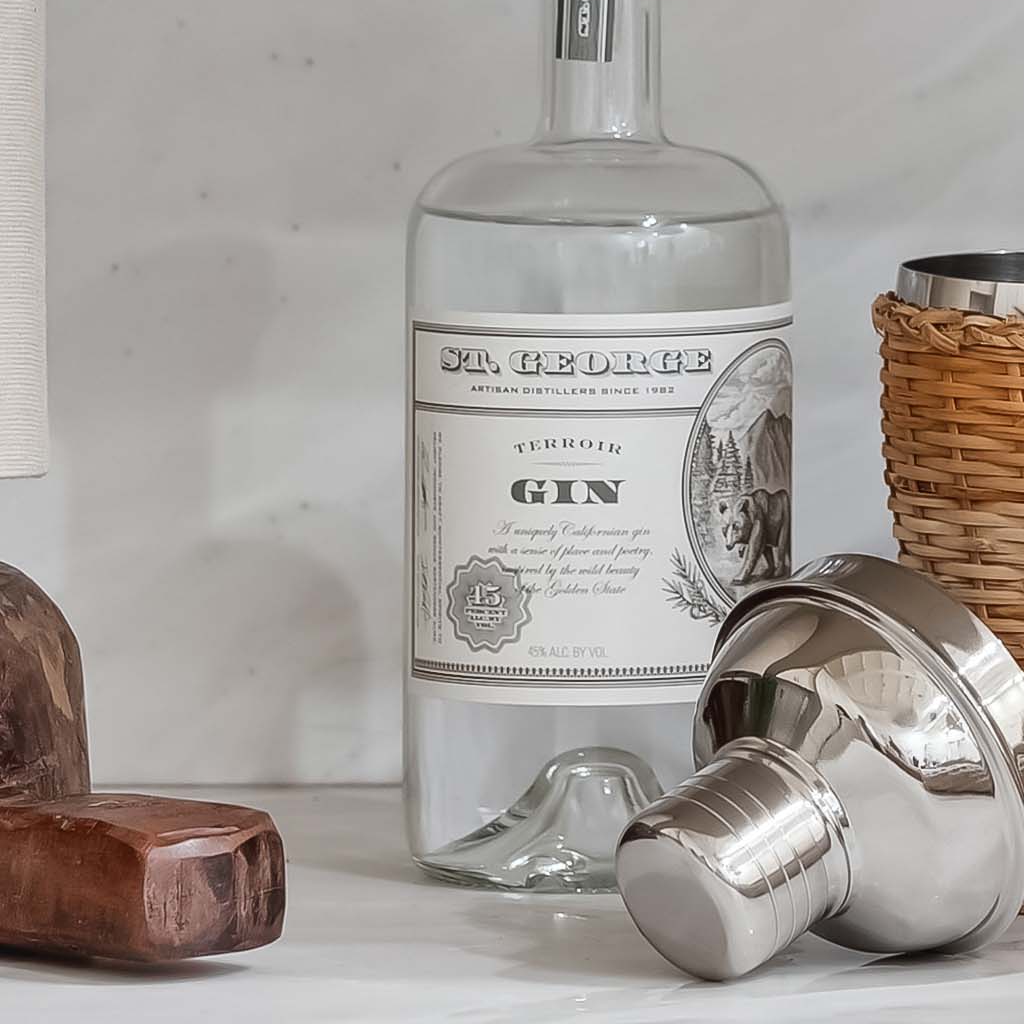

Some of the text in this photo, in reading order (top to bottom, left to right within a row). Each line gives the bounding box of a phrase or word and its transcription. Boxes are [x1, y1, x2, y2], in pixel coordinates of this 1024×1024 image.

[440, 346, 713, 376] ST. GEORGE
[470, 385, 675, 395] ARTISAN DISTILLERS SINCE 1982
[513, 438, 622, 455] TERROIR
[511, 479, 627, 504] GIN
[492, 520, 651, 541] A uniquely Californian gin
[560, 544, 590, 560] place
[592, 544, 617, 556] and
[546, 563, 557, 579] by
[560, 564, 577, 575] the
[578, 564, 605, 575] wild
[606, 564, 641, 579] beauty
[468, 583, 502, 607] 45
[544, 580, 589, 598] Golden
[592, 583, 626, 595] State
[465, 607, 508, 617] PERCENT
[572, 646, 587, 657] BY
